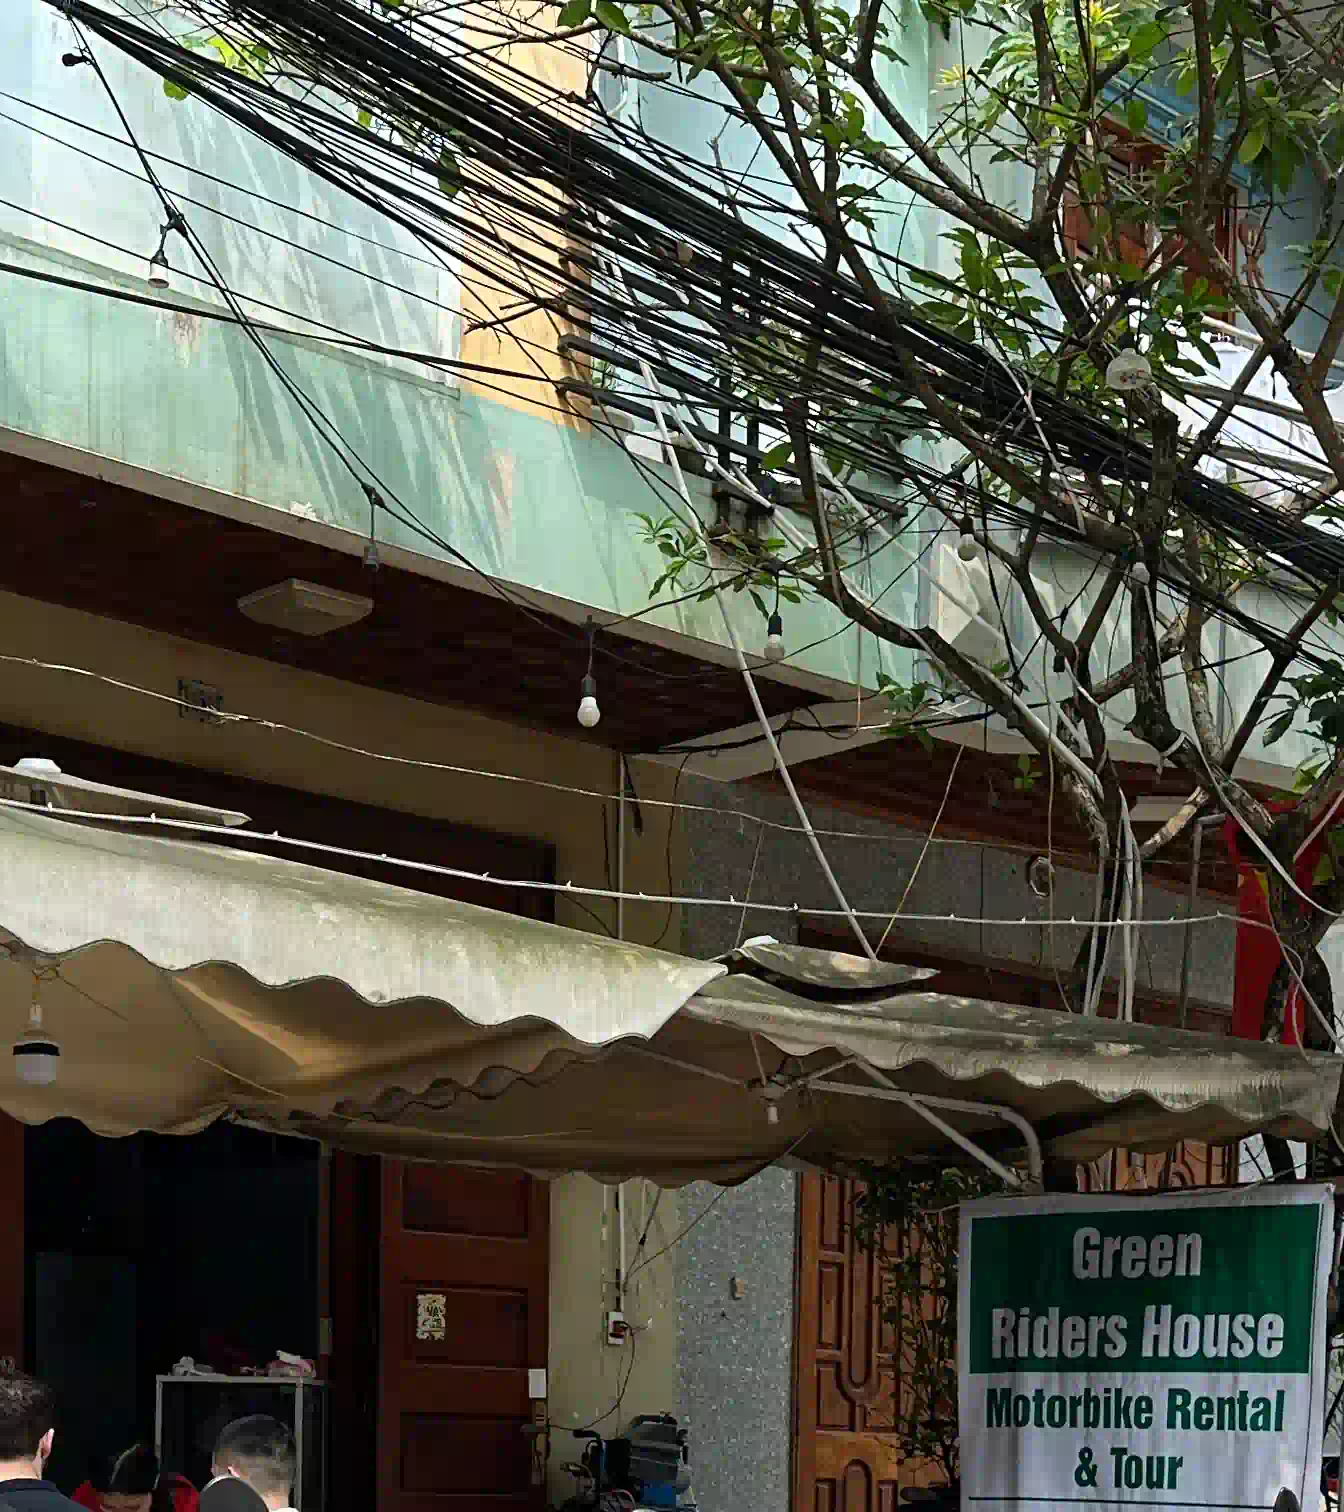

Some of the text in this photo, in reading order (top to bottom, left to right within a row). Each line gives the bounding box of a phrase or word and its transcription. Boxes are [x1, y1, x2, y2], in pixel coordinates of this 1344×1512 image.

[1072, 1226, 1203, 1280] Green
[991, 1304, 1285, 1360] Riders House
[986, 1387, 1285, 1432] Motorbike Rental
[1074, 1446, 1184, 1490] & Tour
